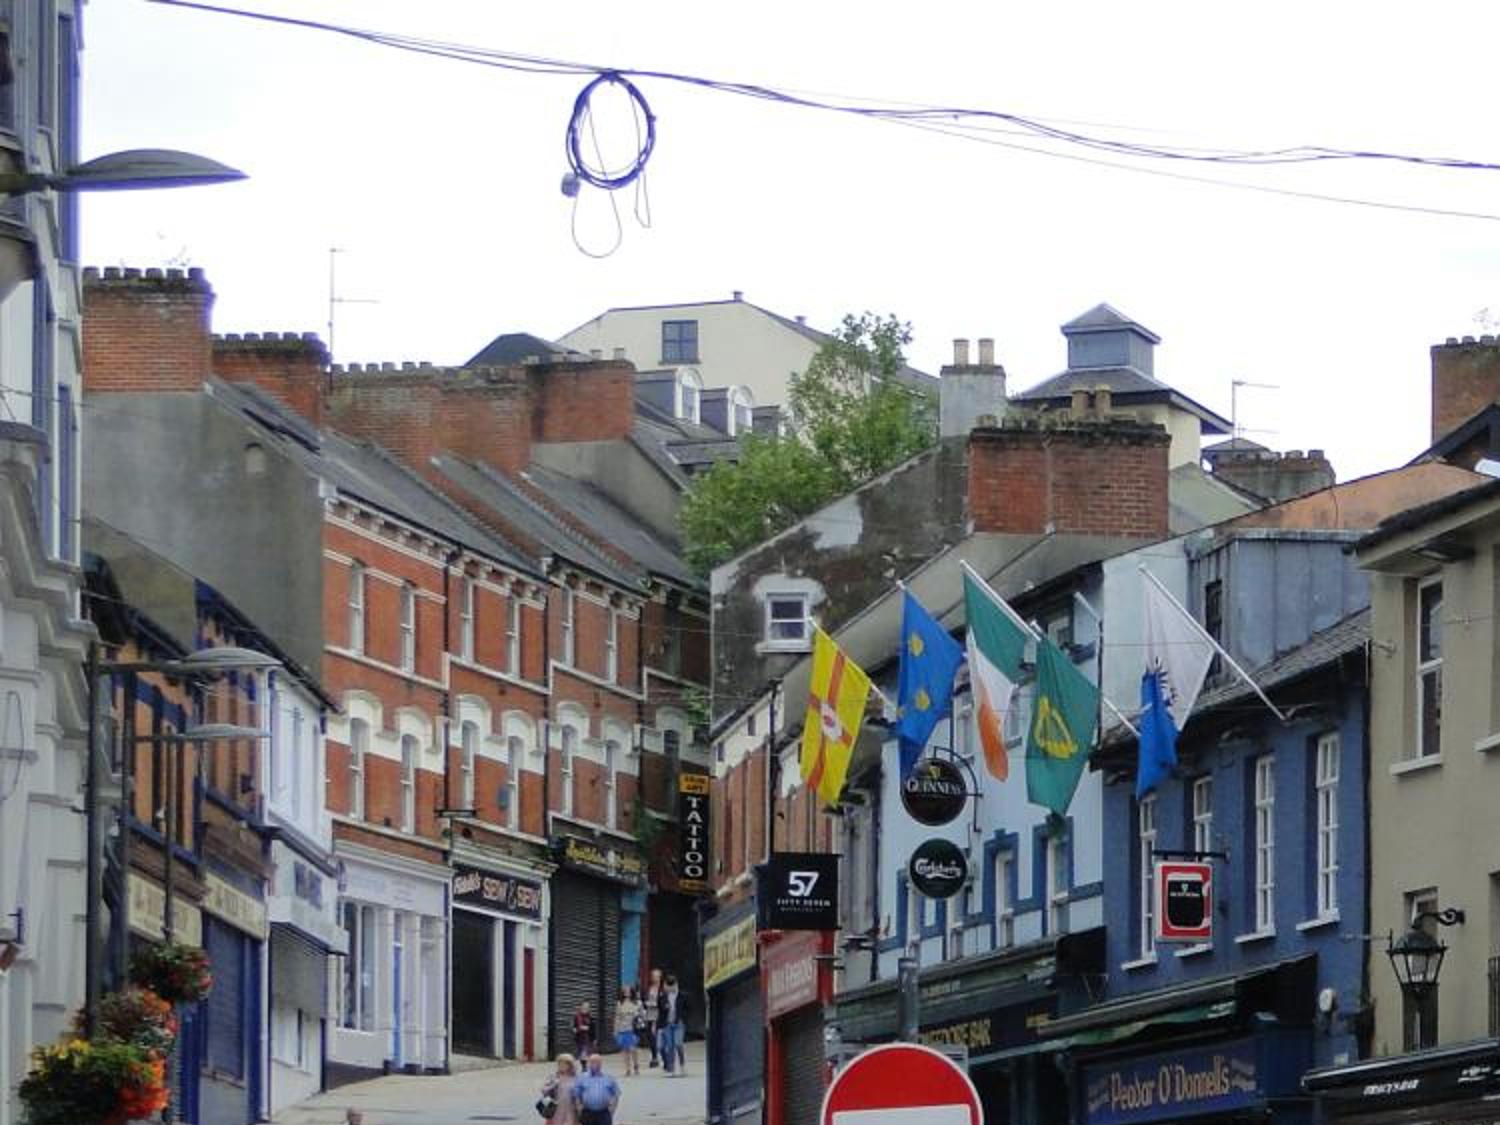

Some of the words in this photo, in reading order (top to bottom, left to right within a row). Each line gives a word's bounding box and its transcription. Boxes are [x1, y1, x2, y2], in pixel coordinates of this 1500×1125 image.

[685, 797, 703, 877] TATTOO
[915, 858, 962, 879] Carlsberg
[788, 871, 819, 897] 57
